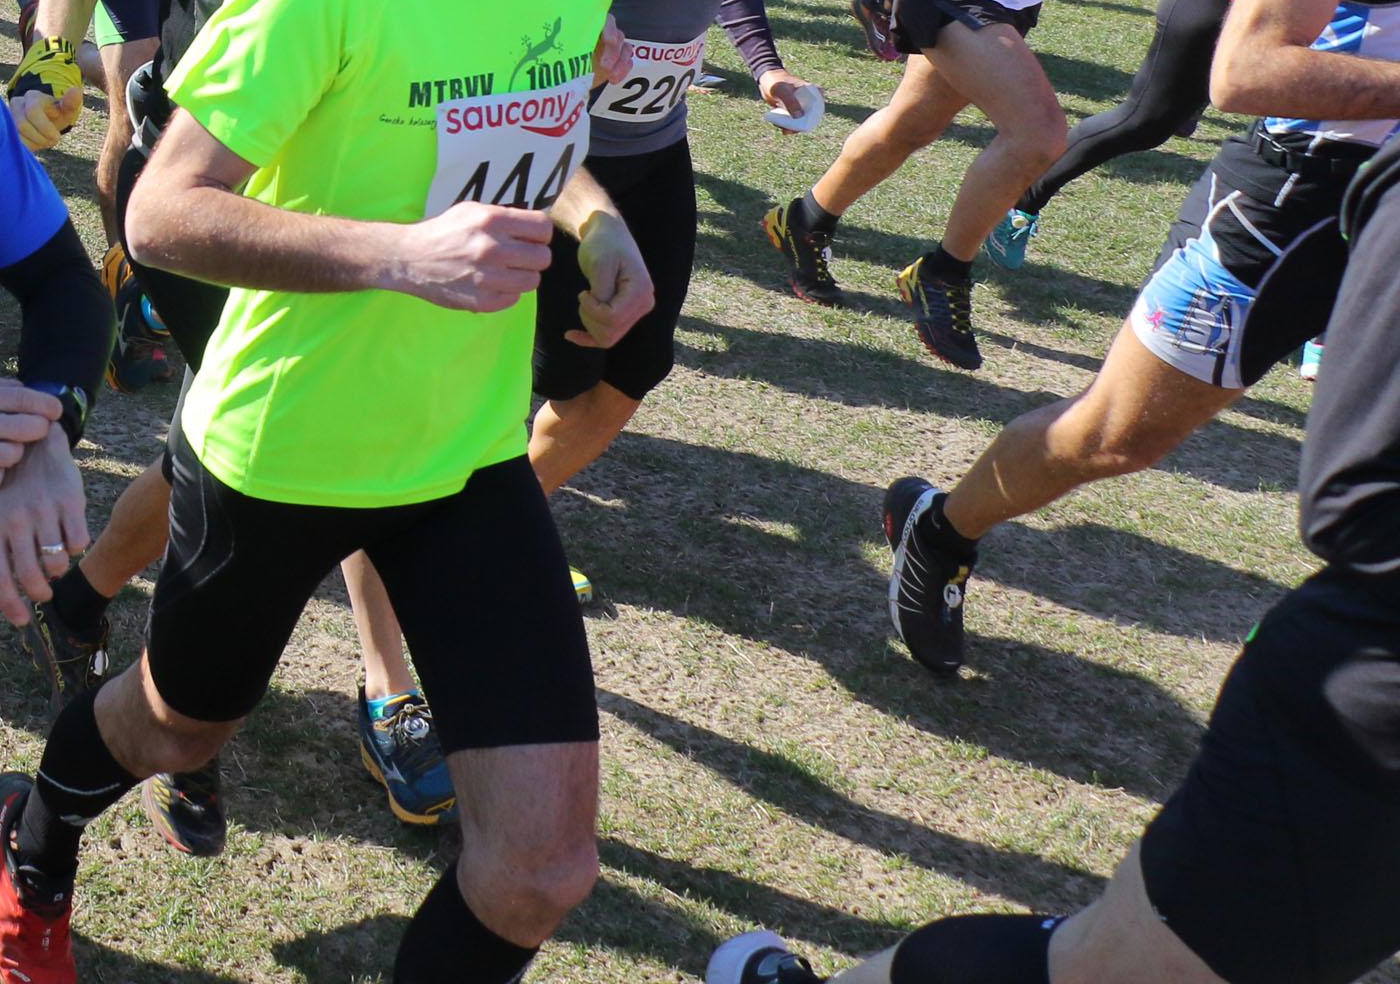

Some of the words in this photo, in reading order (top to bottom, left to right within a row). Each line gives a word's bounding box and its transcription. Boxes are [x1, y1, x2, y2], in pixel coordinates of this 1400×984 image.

[445, 91, 570, 135] saucony
[608, 68, 696, 115] 220
[451, 142, 576, 211] 444
